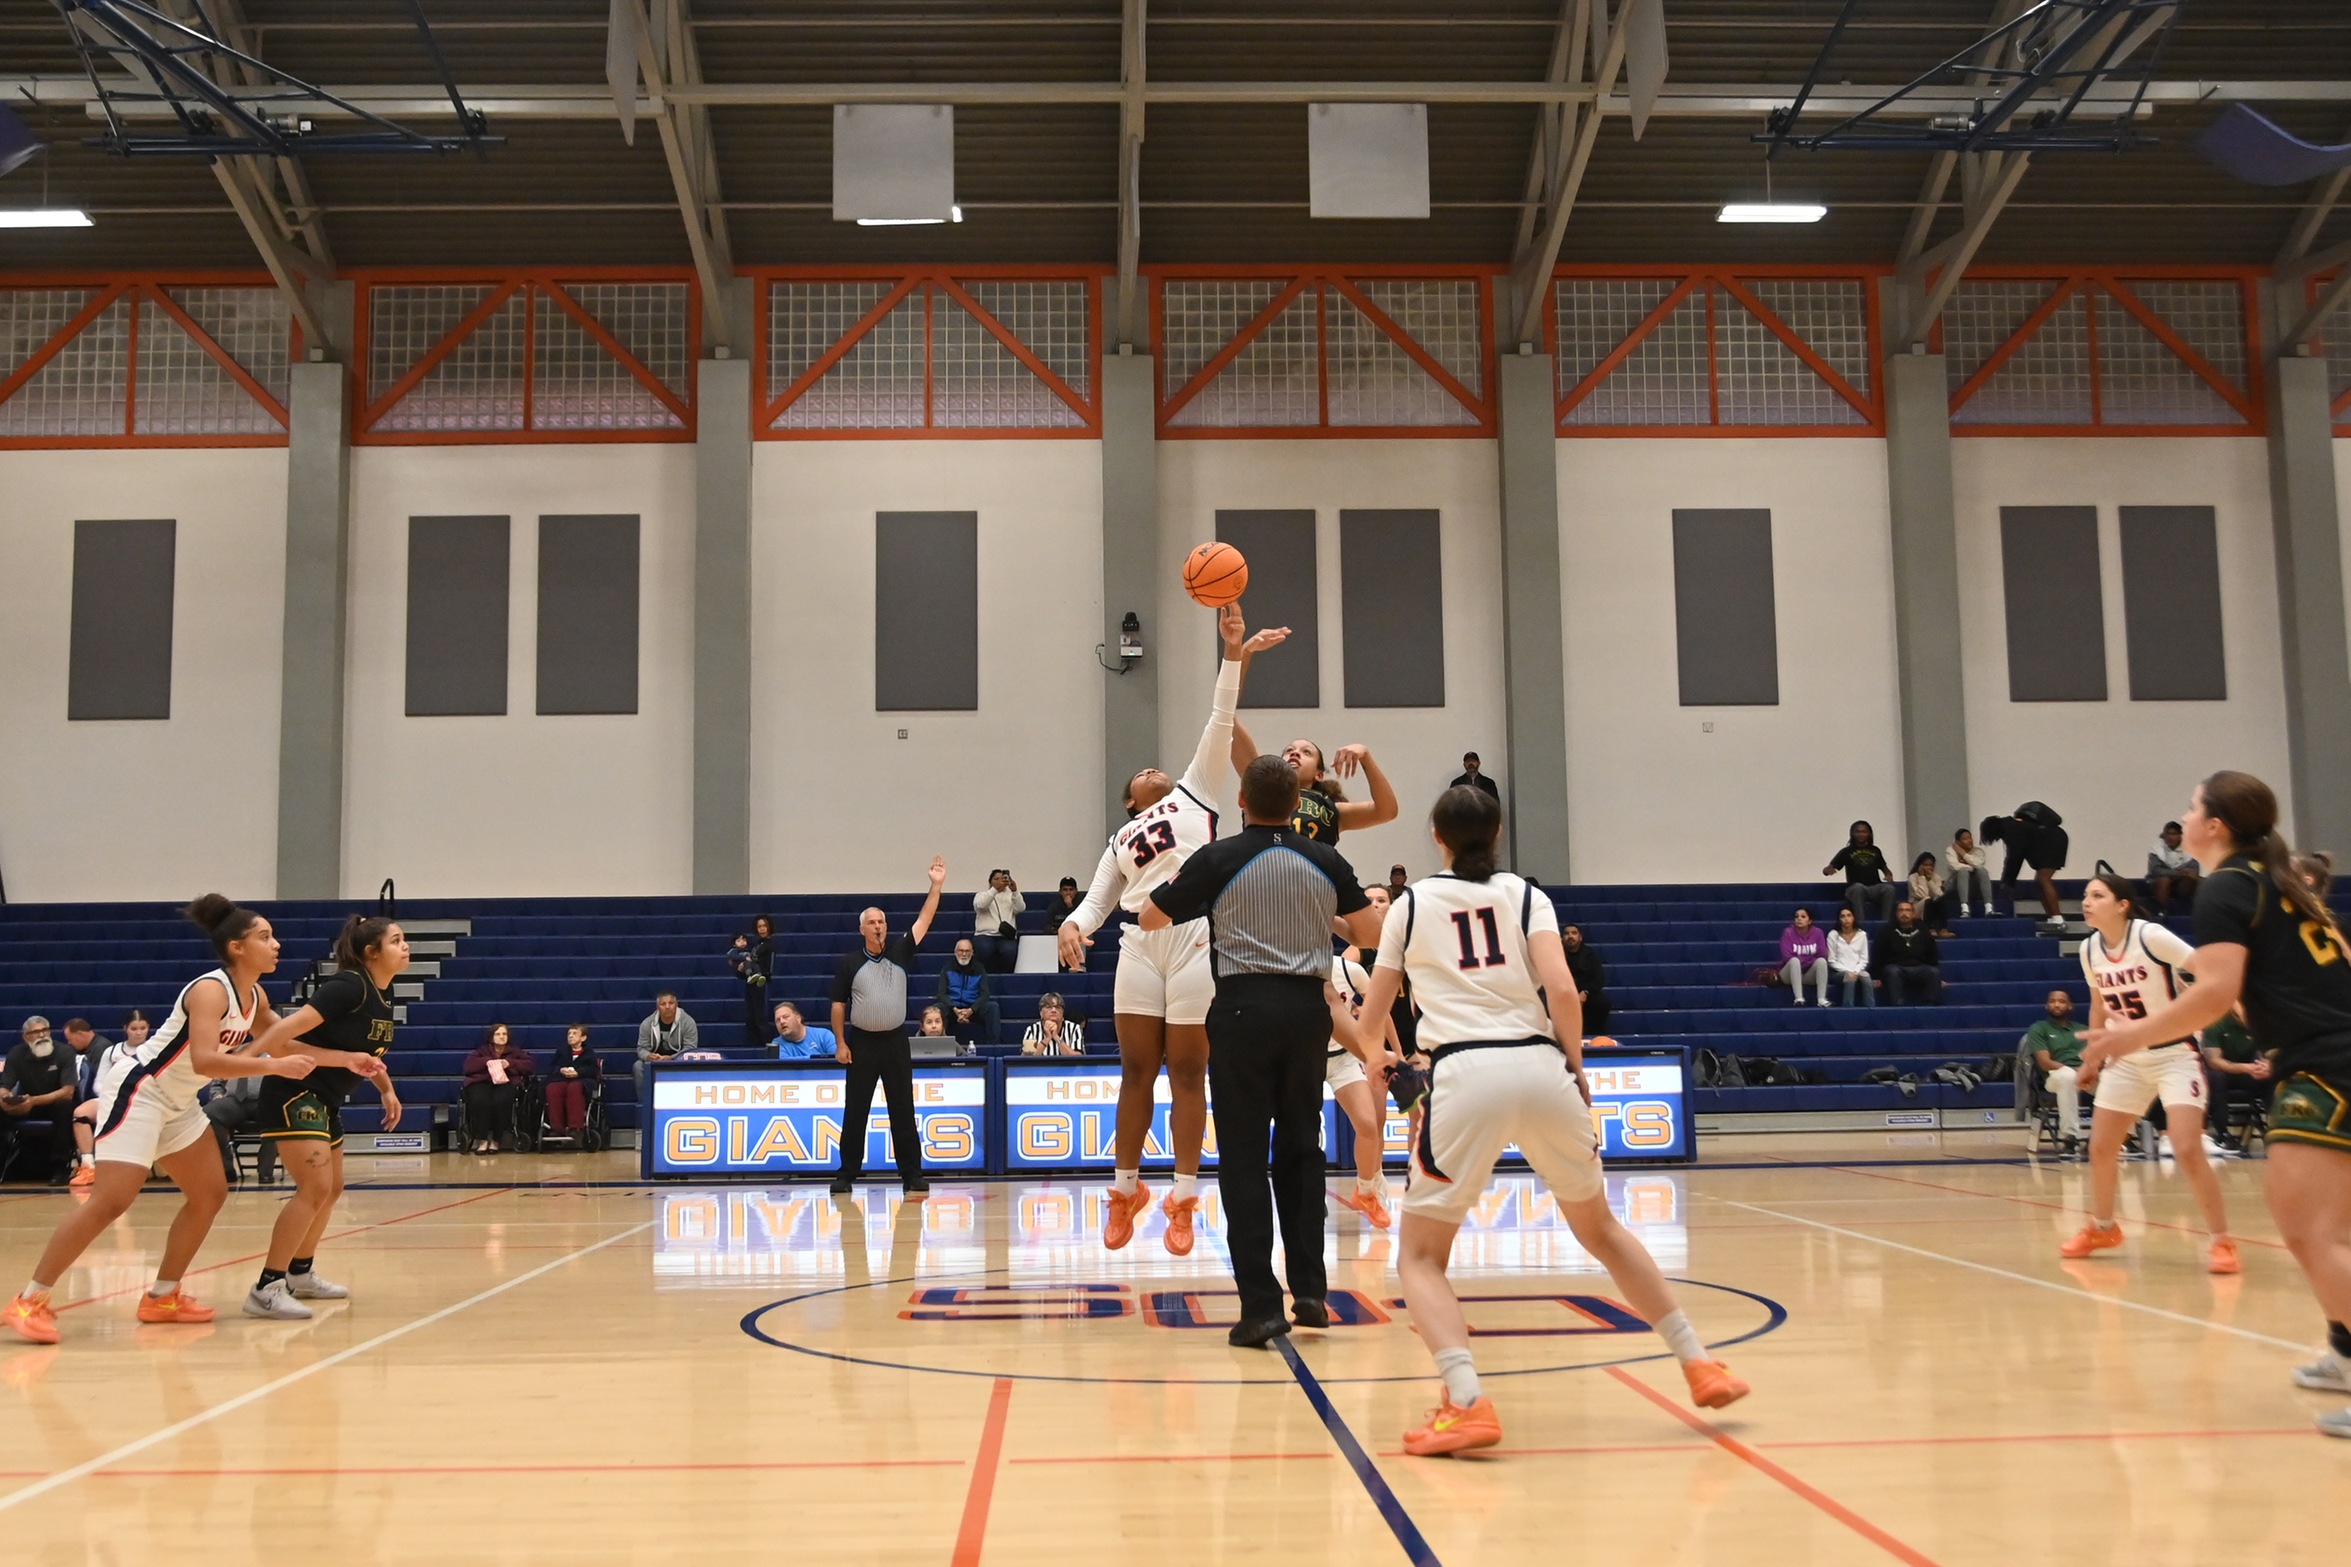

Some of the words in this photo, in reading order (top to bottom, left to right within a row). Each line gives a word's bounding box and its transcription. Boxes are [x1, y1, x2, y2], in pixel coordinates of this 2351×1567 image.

[1297, 797, 1335, 828] RC
[1127, 820, 1177, 869] 33
[1451, 906, 1506, 971] 11
[695, 1085, 799, 1104] HOME
[816, 1084, 839, 1103] O
[1046, 1081, 1121, 1100] HOM
[664, 1113, 975, 1165] GIANTS
